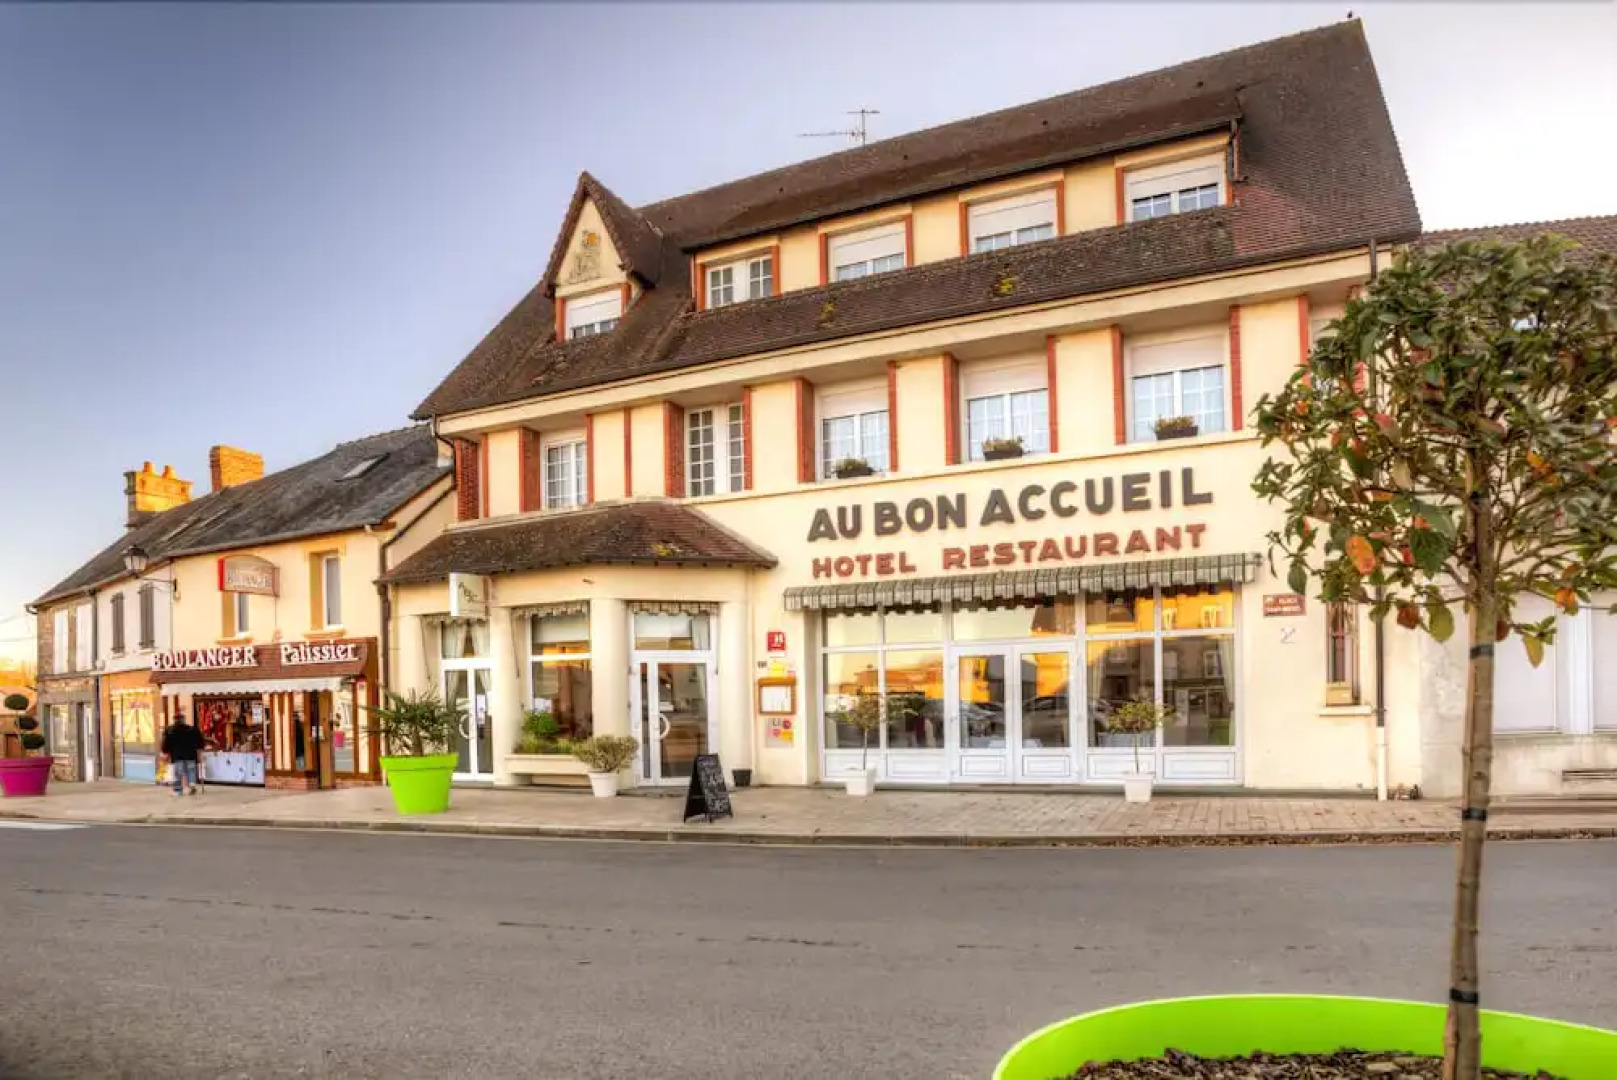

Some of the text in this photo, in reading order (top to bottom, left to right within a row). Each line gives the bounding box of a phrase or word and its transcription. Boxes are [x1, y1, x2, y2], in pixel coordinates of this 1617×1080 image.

[807, 467, 1213, 543] AU BON ACCUEIL
[812, 523, 1206, 580] HOTEL RESTAURANT
[151, 646, 258, 671] BOULANGER
